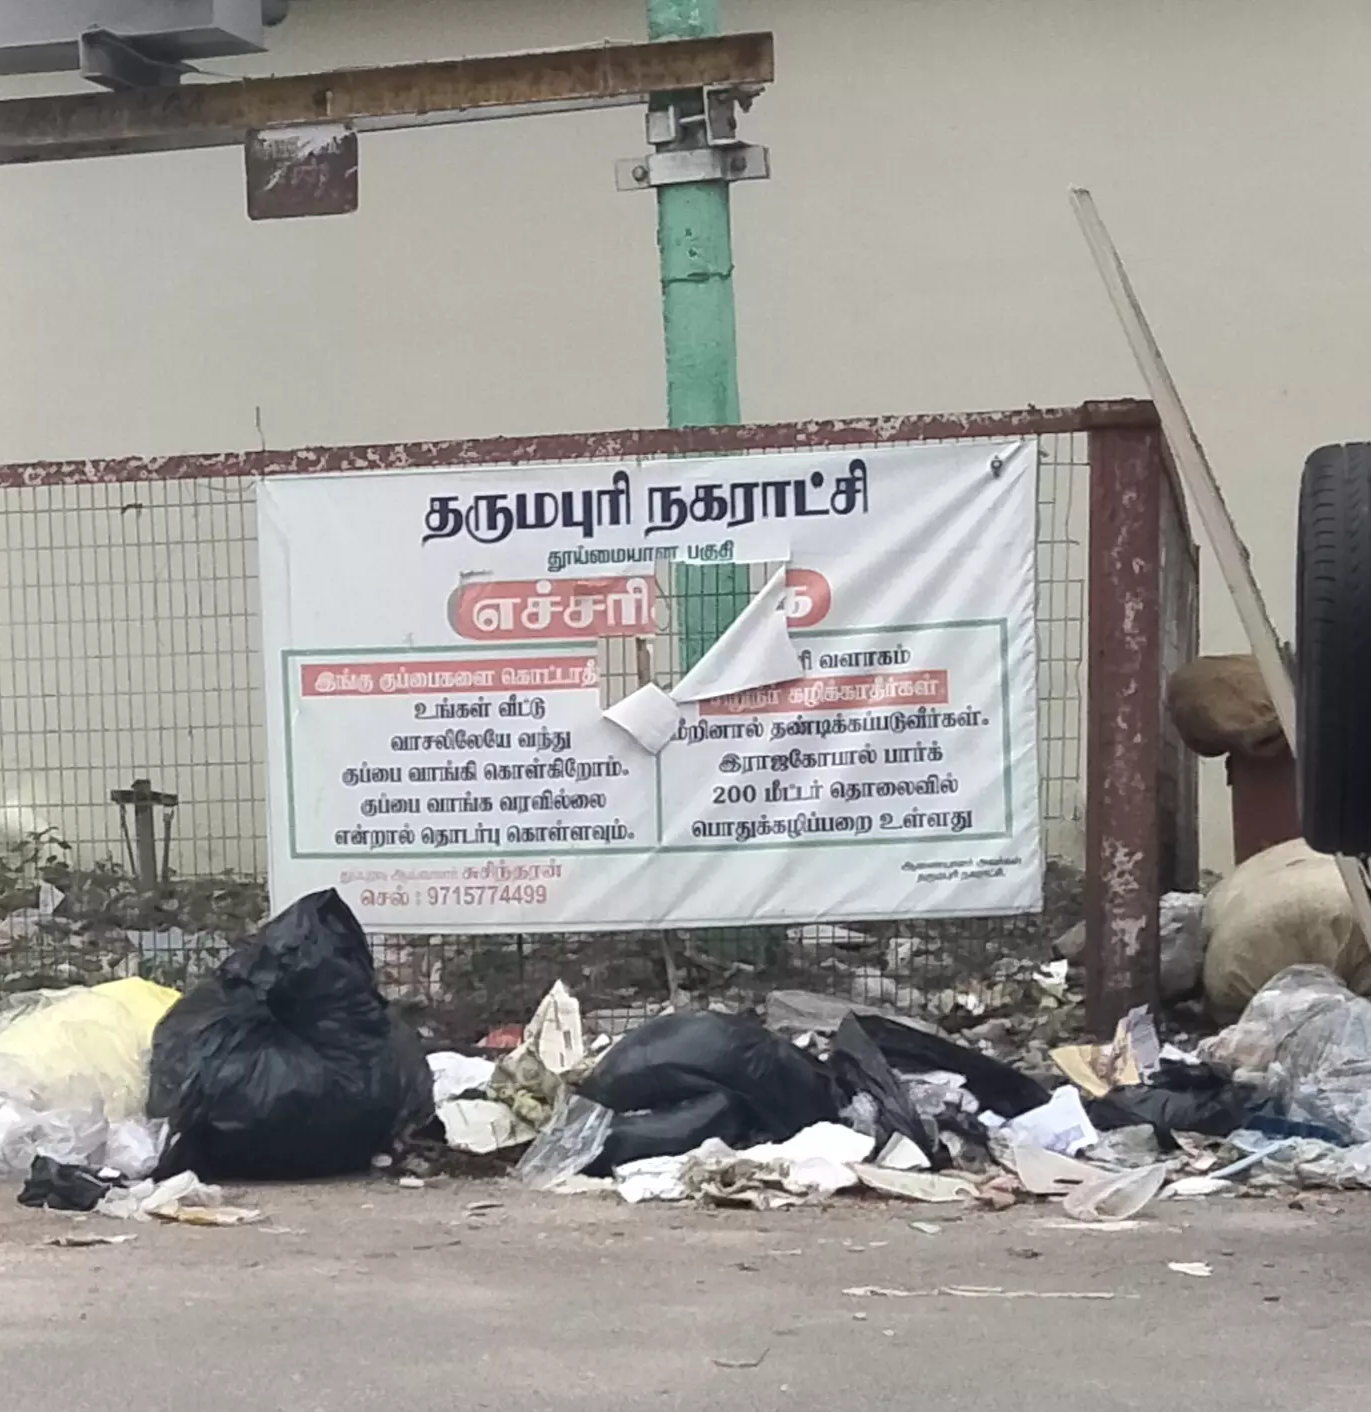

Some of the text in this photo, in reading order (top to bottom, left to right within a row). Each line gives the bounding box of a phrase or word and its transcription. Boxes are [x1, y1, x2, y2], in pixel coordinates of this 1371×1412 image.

[421, 458, 869, 544] தருமபுரி நகராட்சி
[547, 539, 735, 573] தூய்மையான பகுதி
[819, 643, 911, 670] வளாகம்
[314, 668, 374, 693] இங்கு
[379, 665, 494, 692] குப்பைகளை
[414, 692, 546, 720] உங்கள் வீட்டு
[390, 725, 572, 752] வாசலிலேயே வந்து
[718, 740, 944, 775] இராஜகோபால் பார்க்
[341, 760, 403, 786] குப்பை
[408, 760, 478, 783] வாங்கி
[360, 788, 608, 817] குப்பை வாங்க வரவில்லை
[712, 772, 960, 804] 200 மீட்டர் தொலைவில்
[333, 823, 416, 851] என்றால்
[420, 820, 502, 847] தொடர்பு
[691, 807, 974, 841] பொதுக்கழிப்பறை உள்ளது
[361, 883, 410, 906] செல்
[427, 884, 547, 905] 9715774499
